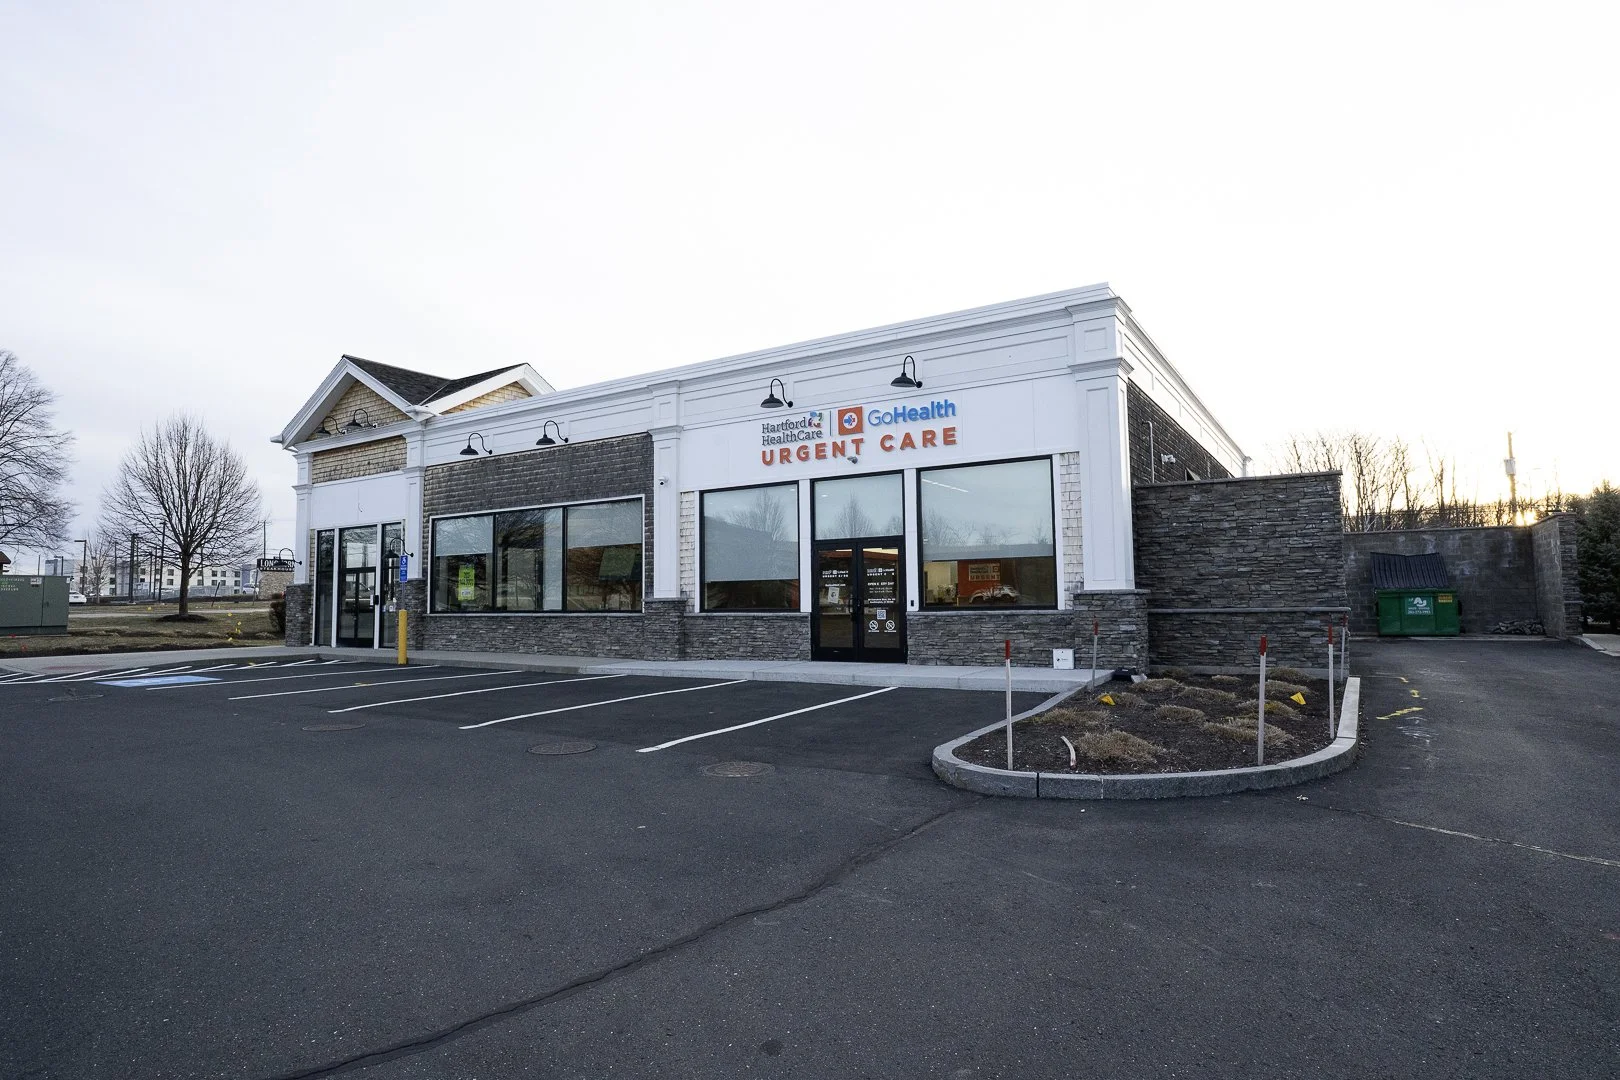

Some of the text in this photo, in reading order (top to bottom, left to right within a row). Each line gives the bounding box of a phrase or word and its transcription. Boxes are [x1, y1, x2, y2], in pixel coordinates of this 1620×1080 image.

[868, 399, 956, 427] GoHealth
[761, 416, 807, 434] Hartford
[761, 428, 823, 446] HealthCare
[761, 426, 957, 466] URGENT CARE
